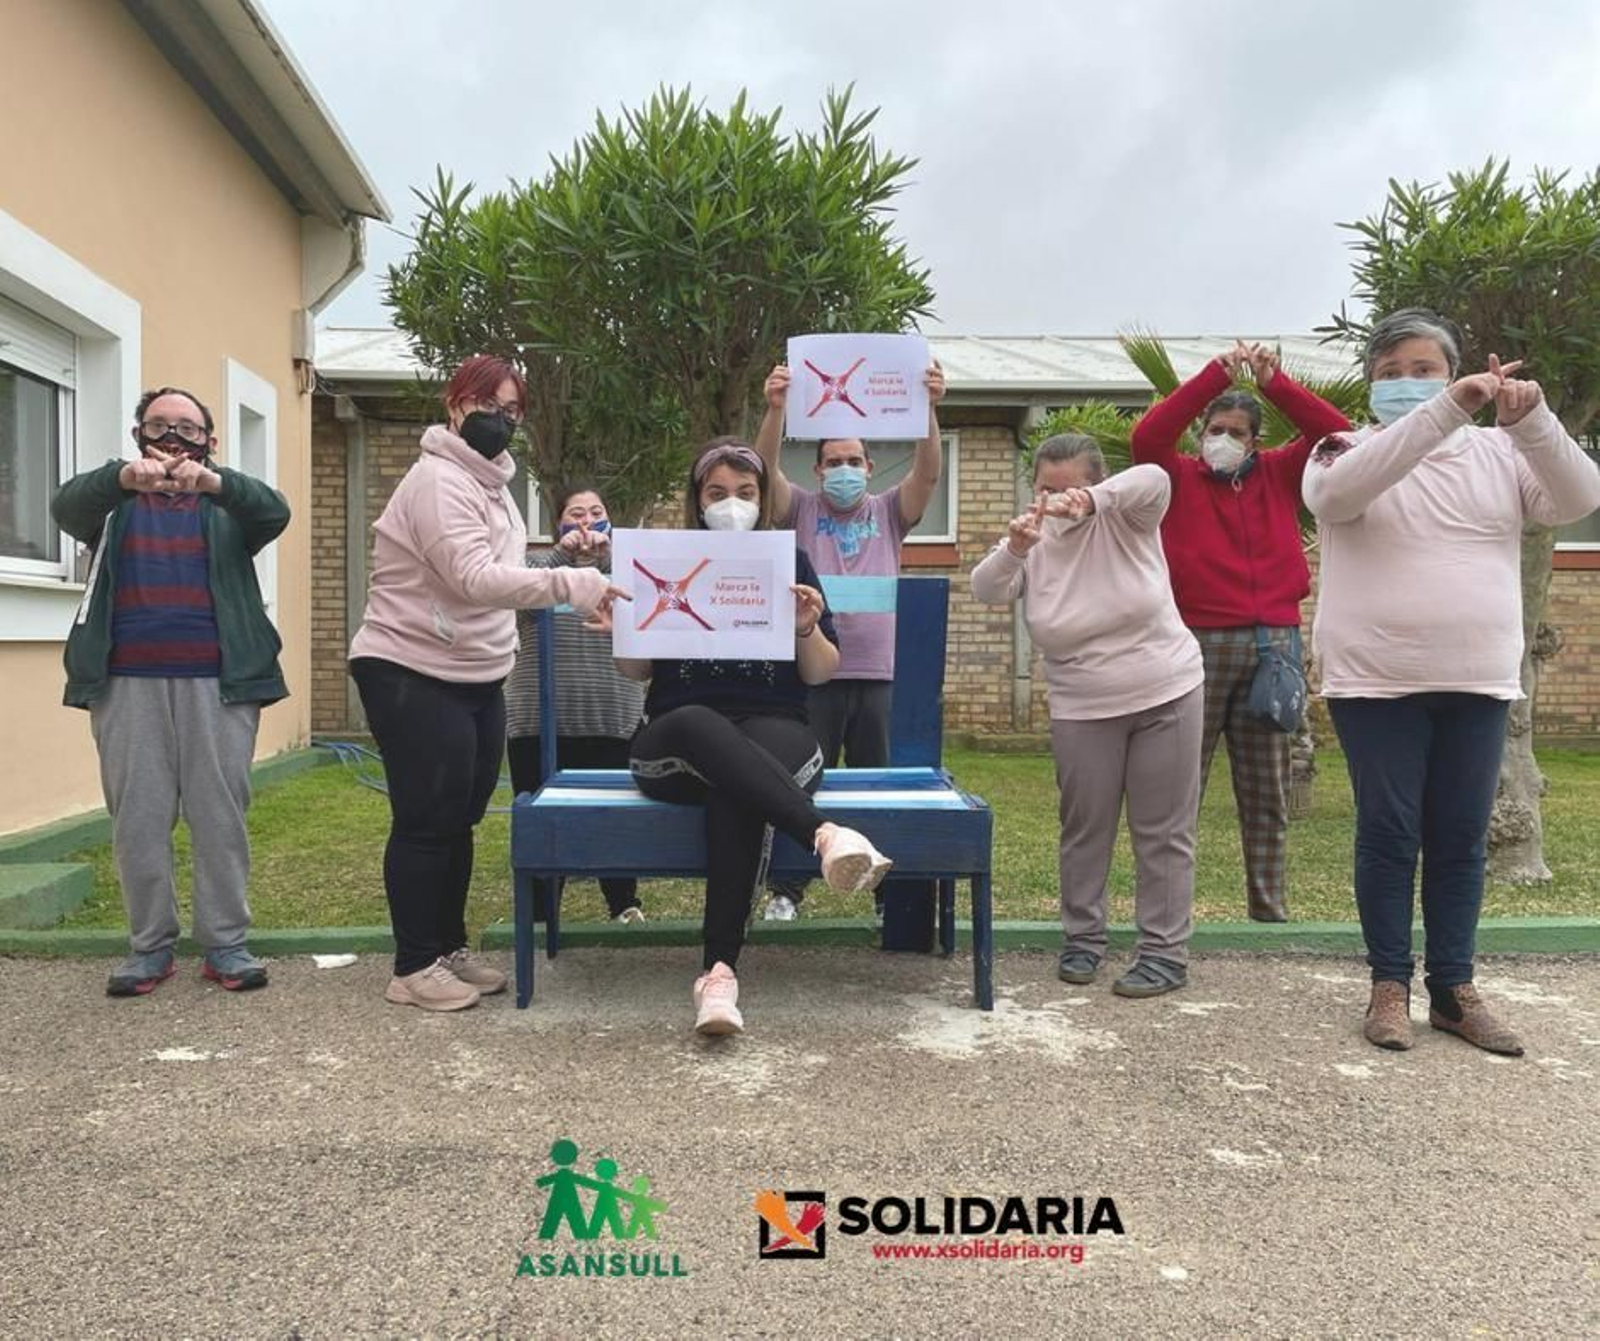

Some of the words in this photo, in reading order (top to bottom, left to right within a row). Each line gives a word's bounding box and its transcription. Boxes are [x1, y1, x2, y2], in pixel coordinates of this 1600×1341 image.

[715, 582, 747, 592] Marca
[750, 582, 760, 592] la
[709, 596, 717, 605] X
[719, 596, 766, 606] Solidaria
